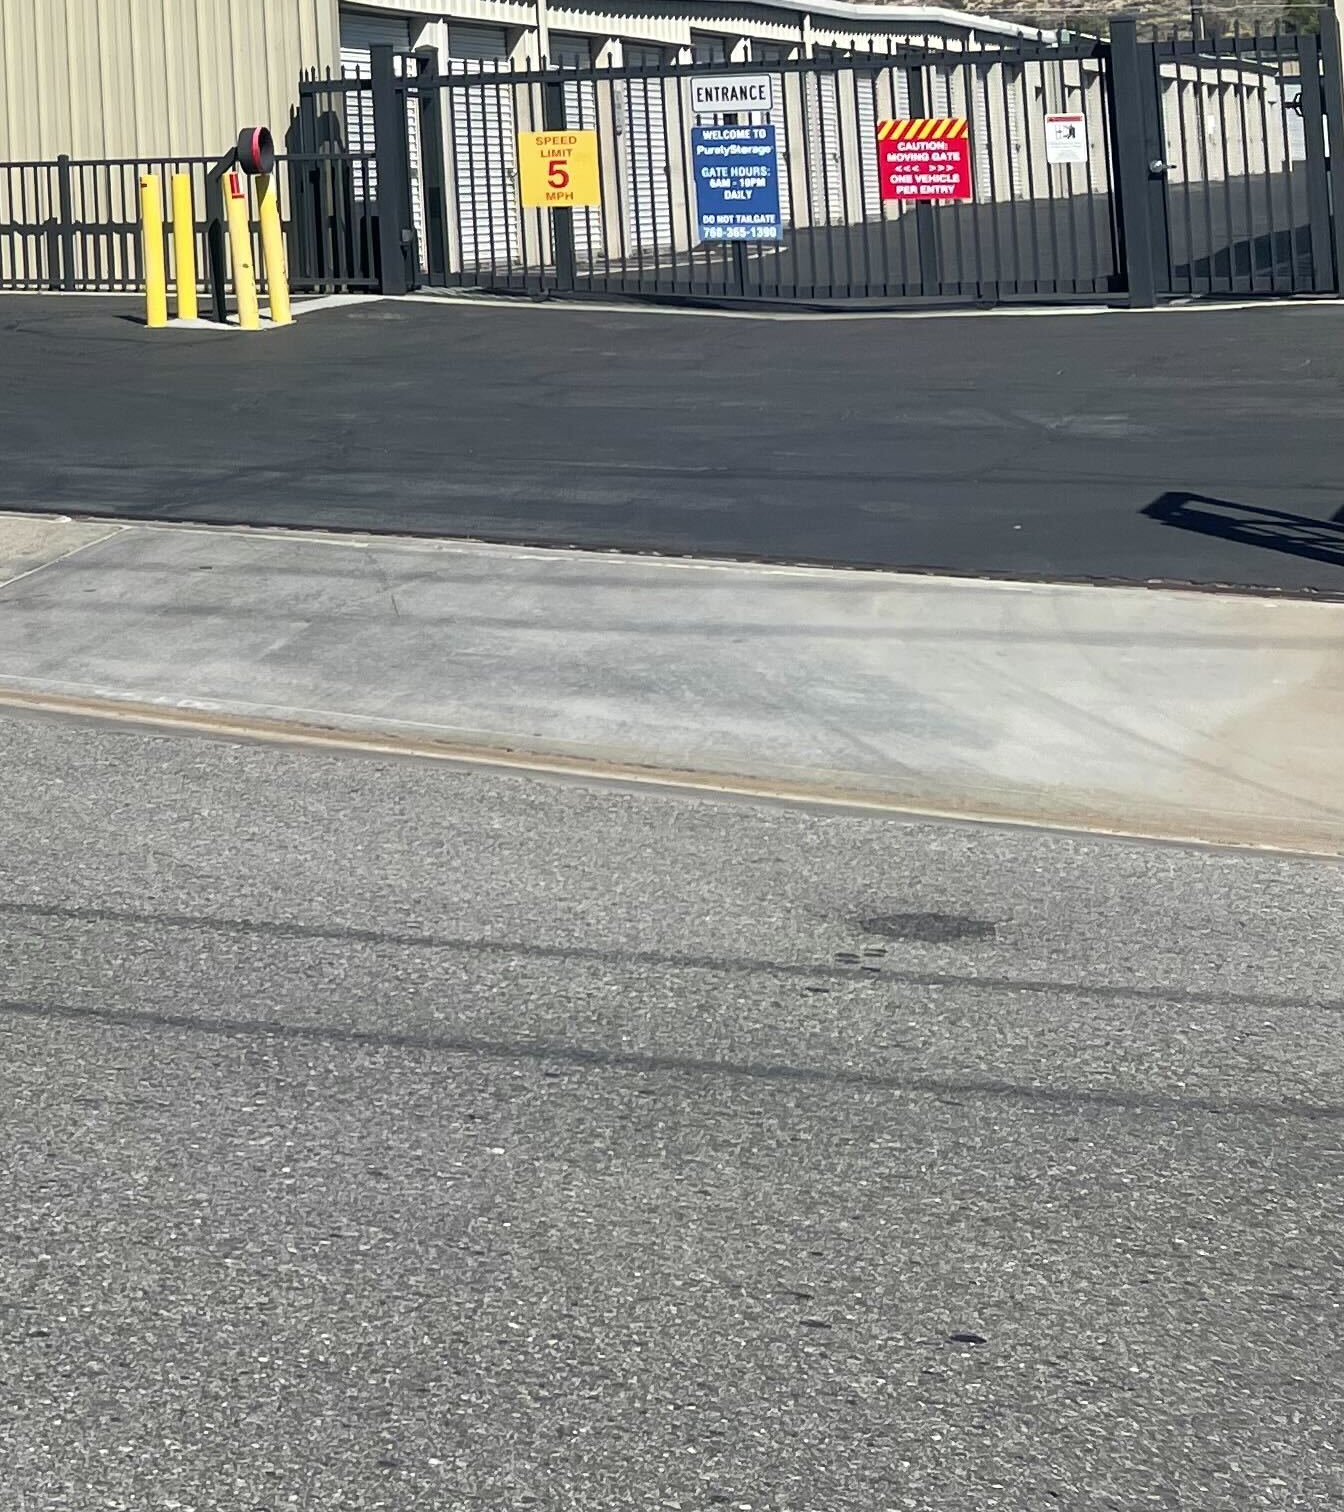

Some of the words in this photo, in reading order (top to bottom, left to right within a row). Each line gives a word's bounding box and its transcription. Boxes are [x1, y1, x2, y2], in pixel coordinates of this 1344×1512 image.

[696, 85, 766, 103] ENTRANCE
[702, 129, 751, 140] WELCOME
[753, 129, 767, 139] TO
[535, 136, 577, 146] SPEED
[897, 140, 948, 151] CAUTION:
[540, 148, 573, 158] LIMIT
[886, 152, 929, 162] MOVING
[931, 151, 960, 161] GATE
[548, 160, 569, 188] 5
[701, 167, 728, 178] GATE
[730, 166, 771, 177] HOURS:
[709, 178, 731, 188] 6AM
[739, 177, 766, 188] 10PM
[889, 174, 913, 184] ONE
[914, 173, 960, 183] VEHICLE
[724, 189, 752, 200] DAILY
[896, 185, 918, 195] PER
[919, 184, 955, 195] ENTRY
[545, 192, 574, 201] MPH
[702, 214, 715, 224] DO
[716, 214, 734, 224] NOT
[735, 214, 776, 224] TAILGATE
